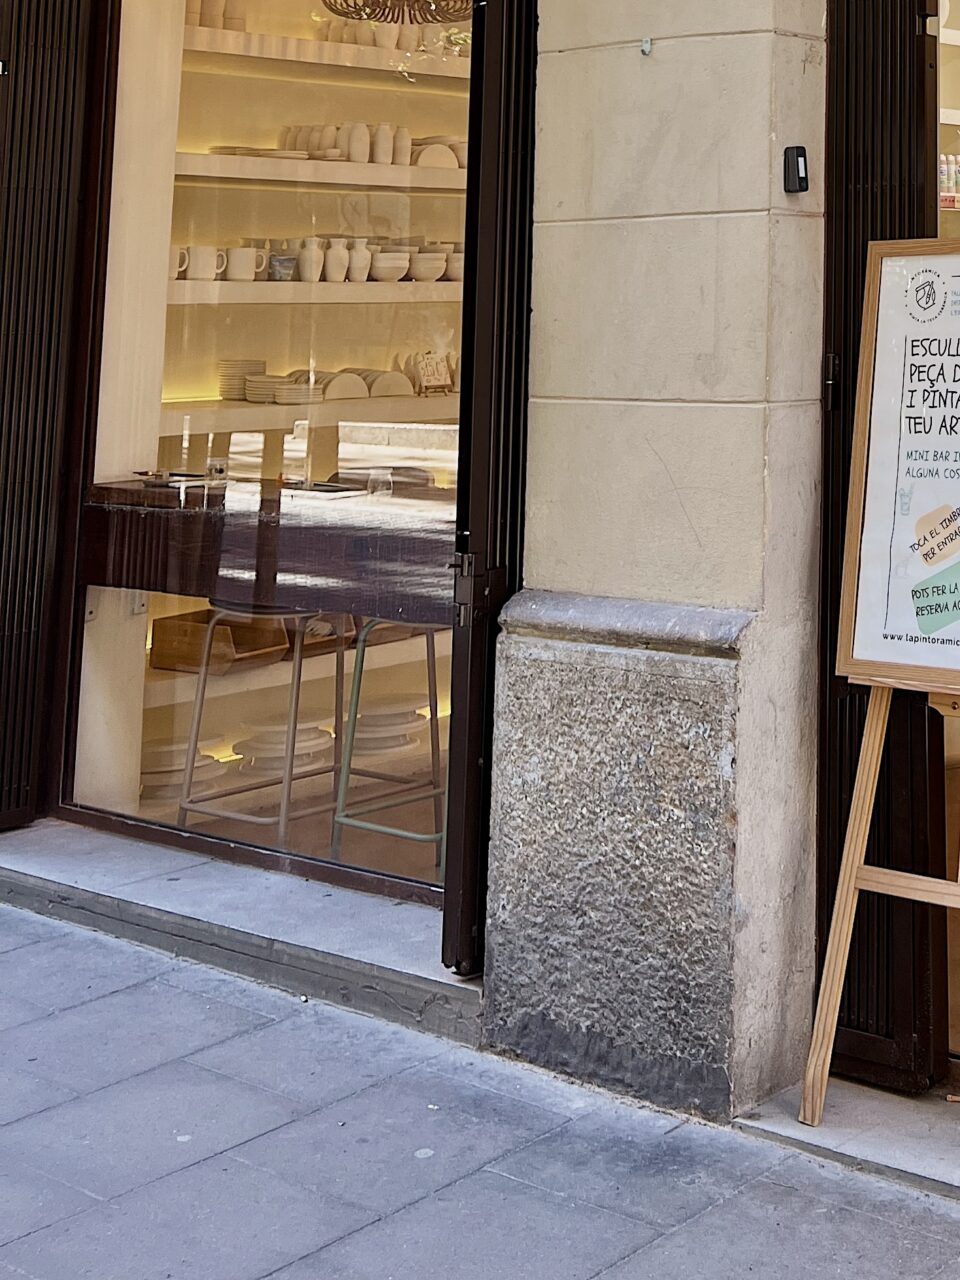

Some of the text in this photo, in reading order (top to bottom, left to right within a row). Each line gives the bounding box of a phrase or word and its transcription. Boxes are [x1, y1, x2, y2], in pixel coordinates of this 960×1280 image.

[910, 363, 946, 388] PEÇA
[906, 389, 918, 408] I
[905, 415, 933, 435] TEU
[906, 450, 930, 462] MINI
[933, 450, 950, 462] BAR
[905, 467, 940, 479] ALGUNA
[908, 535, 929, 553] TOCA
[929, 527, 941, 540] EL
[922, 547, 936, 562] PER
[911, 588, 930, 601] POTS
[932, 584, 947, 597] FER
[949, 582, 959, 594] LA
[915, 604, 950, 617] RESERVA
